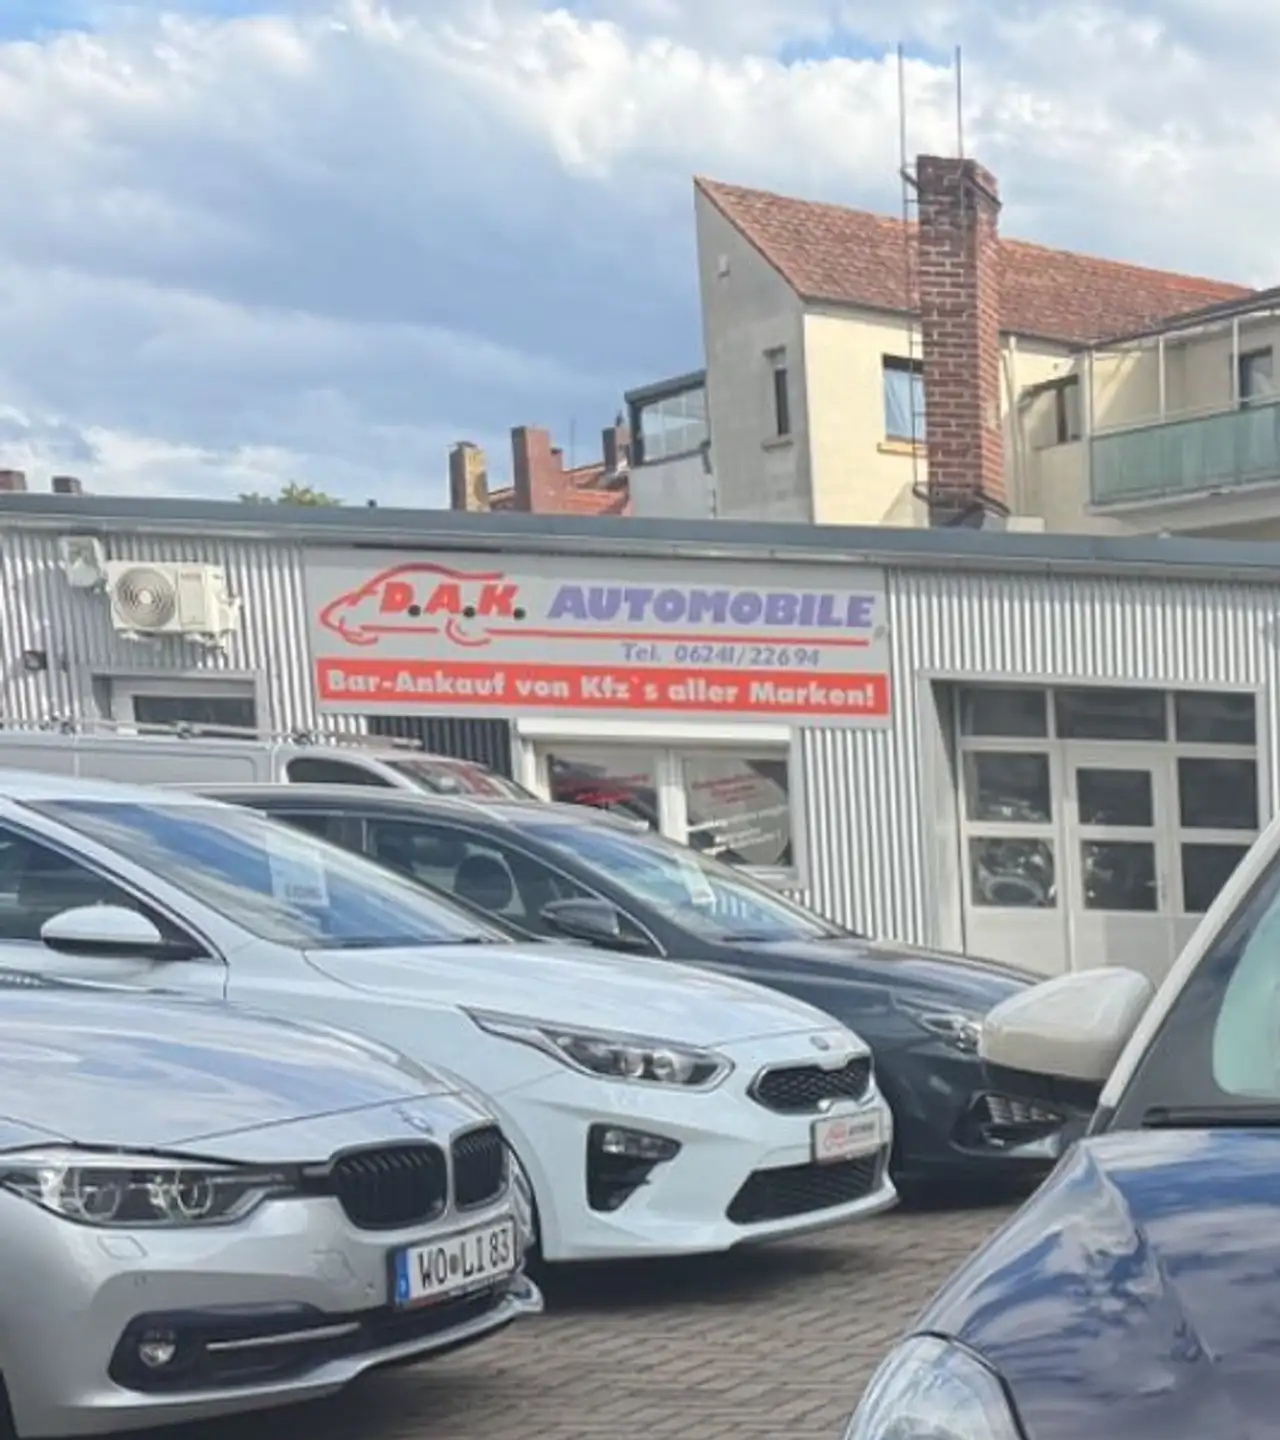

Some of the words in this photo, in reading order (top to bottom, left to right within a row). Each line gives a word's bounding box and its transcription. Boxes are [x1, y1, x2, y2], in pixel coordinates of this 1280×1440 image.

[379, 581, 526, 620] D.A.K.
[546, 585, 876, 628] AUTOMOBILE
[620, 642, 662, 662] Tel.
[674, 644, 821, 667] 06241/22694
[327, 669, 506, 696] Bar-Ankauf
[515, 679, 570, 698] von
[668, 677, 740, 704] aller
[748, 680, 875, 708] Marken!
[418, 1246, 448, 1290] WO
[489, 1227, 510, 1269] 83
